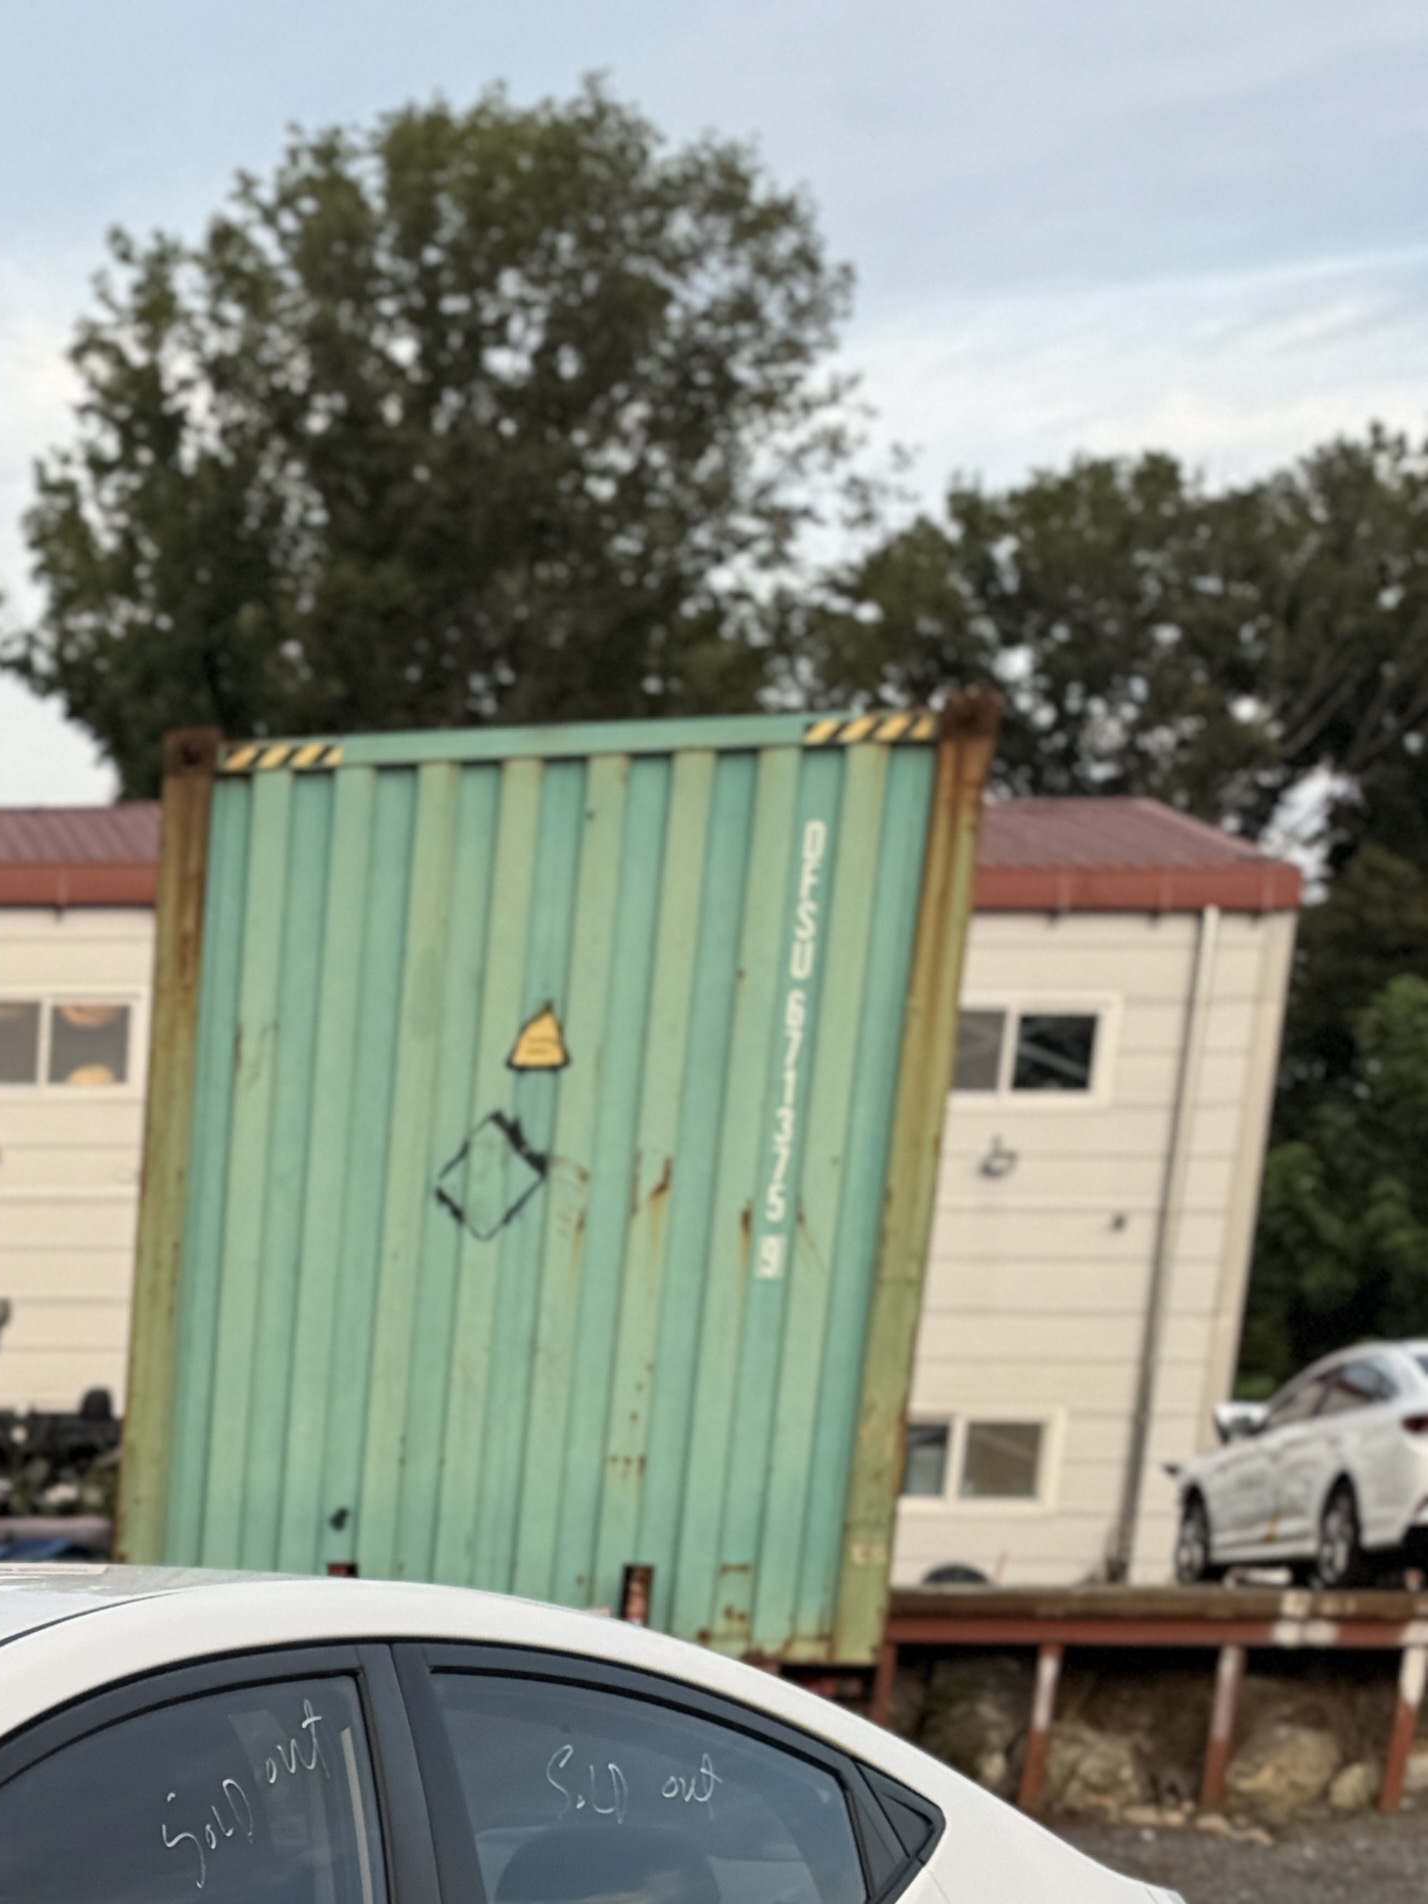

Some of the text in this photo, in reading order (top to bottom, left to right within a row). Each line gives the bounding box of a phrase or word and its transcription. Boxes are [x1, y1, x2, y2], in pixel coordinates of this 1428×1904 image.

[791, 819, 827, 979] DFSU
[764, 988, 807, 1222] 671375
[661, 1752, 724, 1818] out
